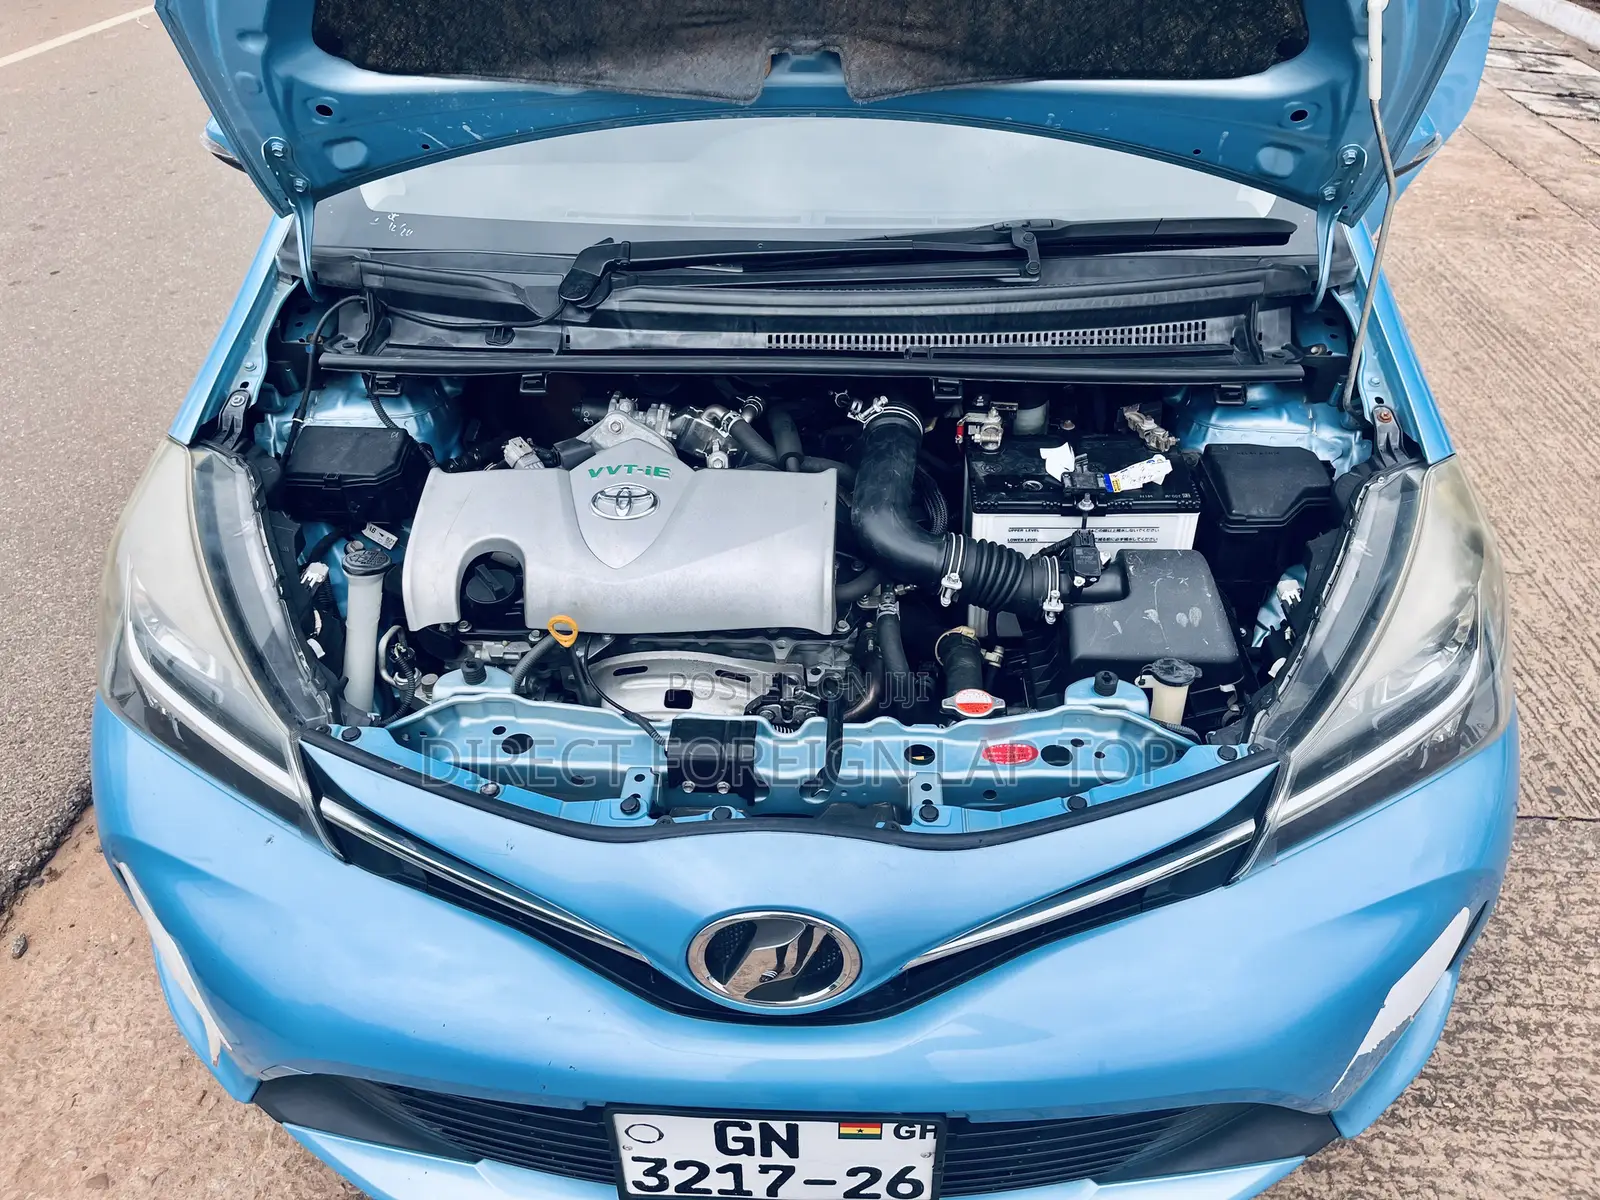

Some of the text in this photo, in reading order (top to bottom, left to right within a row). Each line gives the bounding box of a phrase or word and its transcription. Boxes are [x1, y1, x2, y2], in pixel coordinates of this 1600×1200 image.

[588, 464, 671, 479] VVT-iE
[714, 1120, 799, 1158] GN
[631, 1156, 925, 1199] 3217-26
